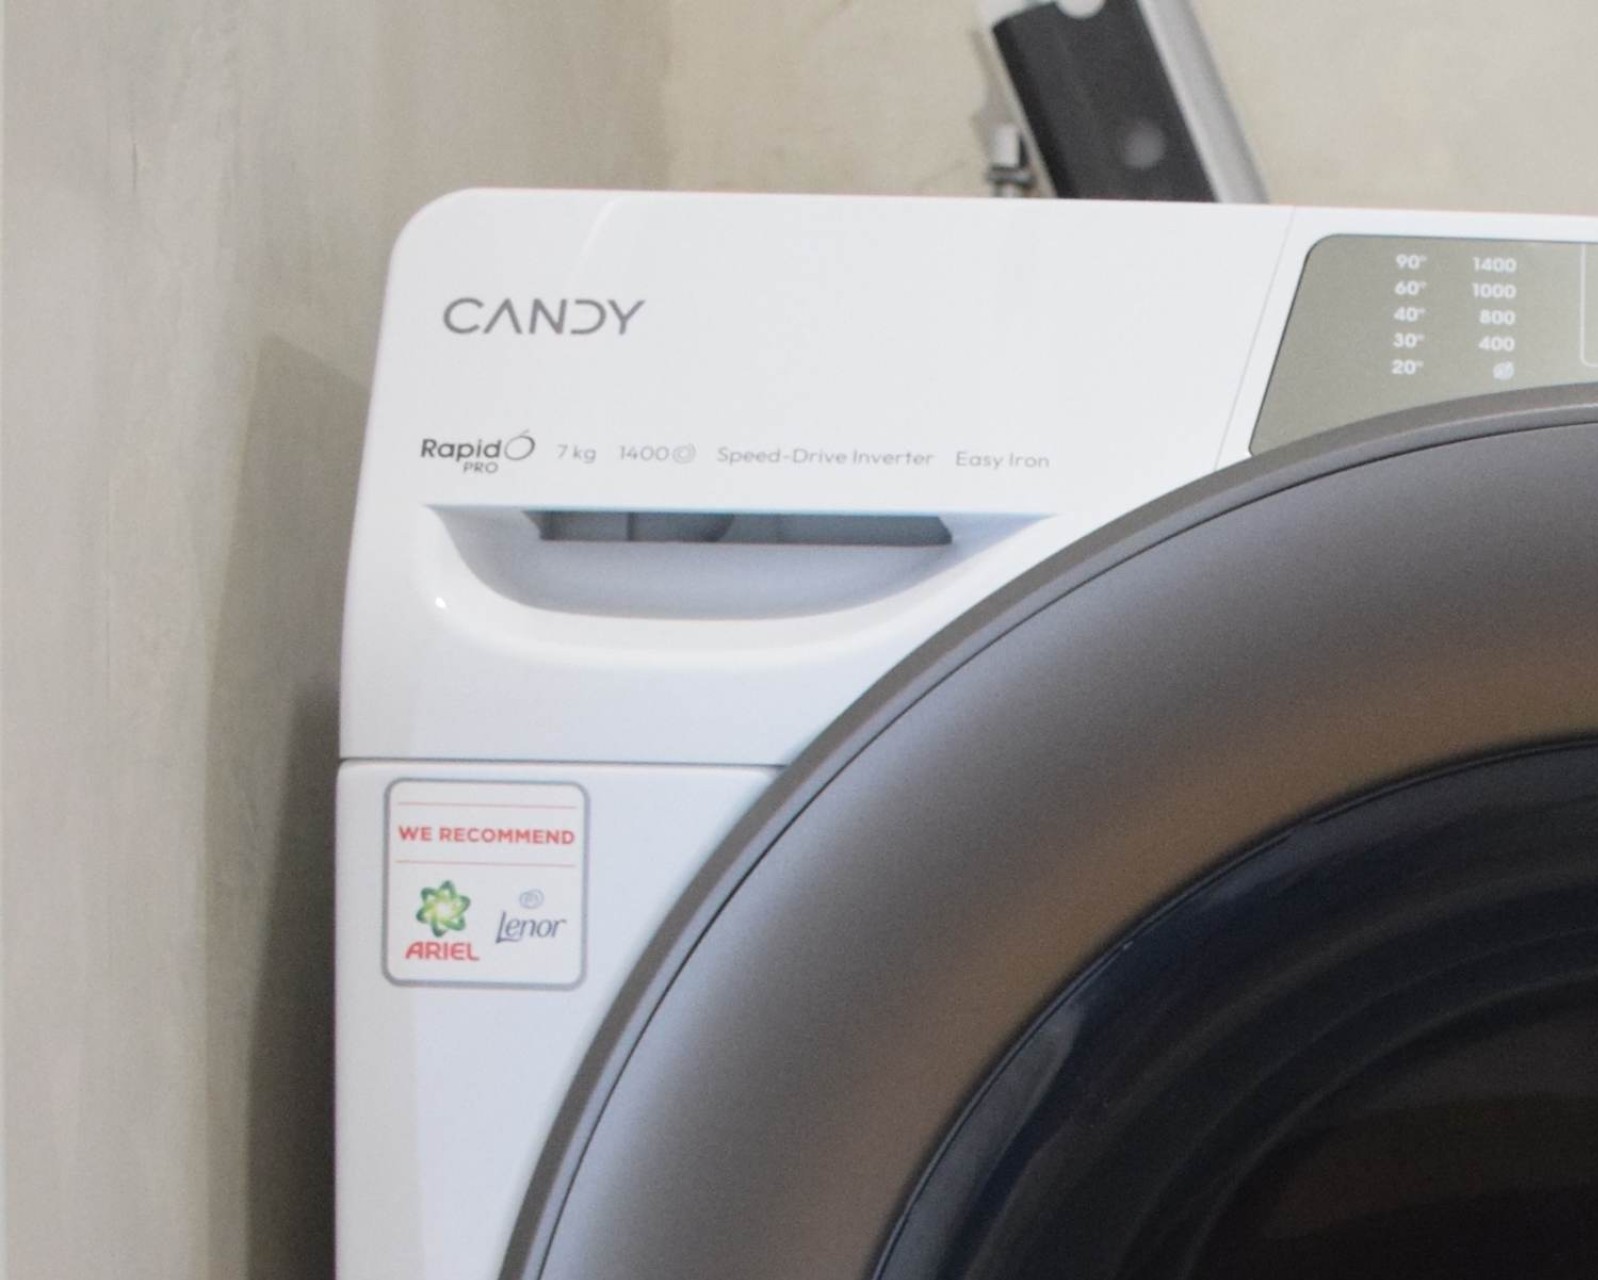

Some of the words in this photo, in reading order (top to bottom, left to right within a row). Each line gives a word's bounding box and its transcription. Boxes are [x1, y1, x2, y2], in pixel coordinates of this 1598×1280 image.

[1473, 257, 1516, 272] 1400
[1473, 283, 1516, 298] 1000
[442, 297, 645, 336] CANDY
[1479, 310, 1515, 325] 800
[1478, 336, 1515, 351] 400
[557, 444, 568, 459] 7
[573, 443, 597, 464] kg
[619, 445, 670, 462] 1400
[853, 449, 935, 466] Inverter
[956, 451, 1004, 471] Easy
[1009, 452, 1051, 468] Iron
[463, 461, 499, 473] PRO
[398, 826, 432, 841] WE
[439, 828, 575, 844] RECOMMEND
[495, 911, 568, 944] Lenor
[405, 941, 480, 962] ARIEL
